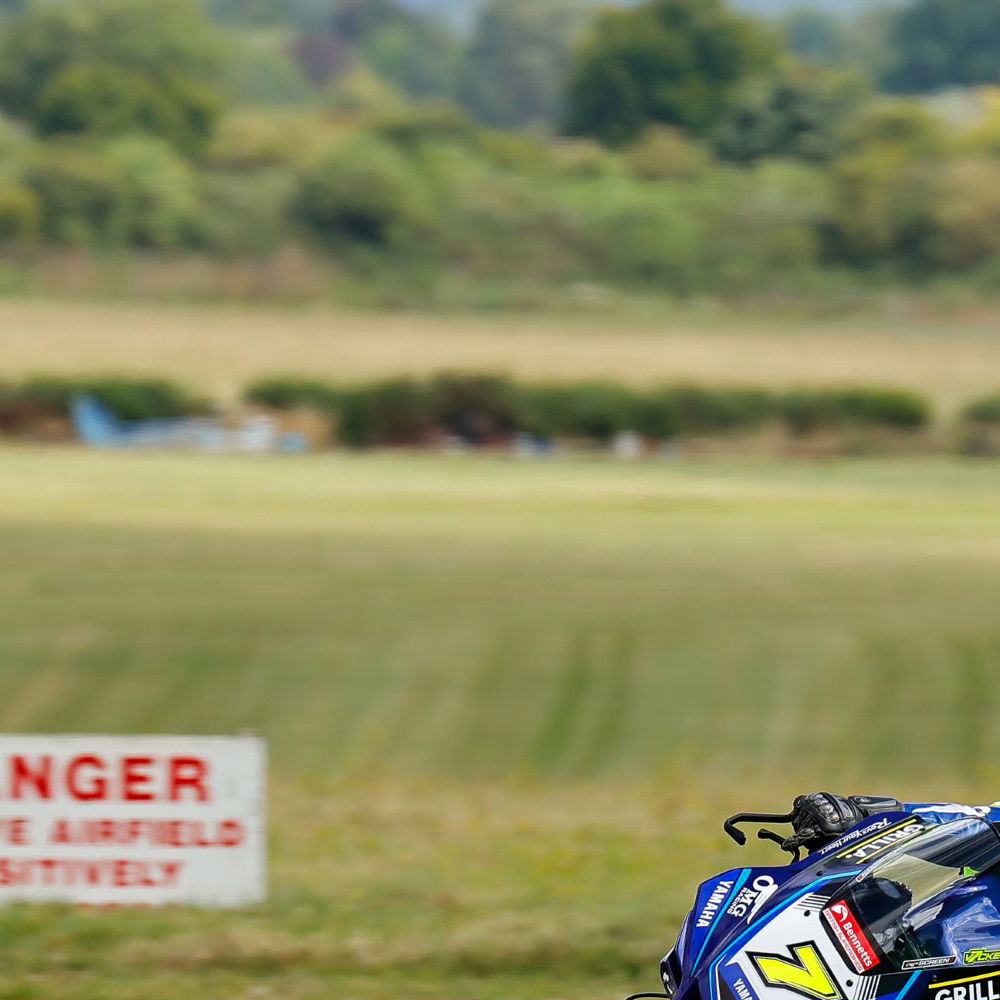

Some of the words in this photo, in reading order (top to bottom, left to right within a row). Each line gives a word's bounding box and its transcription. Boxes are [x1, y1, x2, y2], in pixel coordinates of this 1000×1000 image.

[0, 755, 209, 802] NGER
[696, 880, 734, 928] YAMAHA
[843, 922, 873, 967] Bennetts
